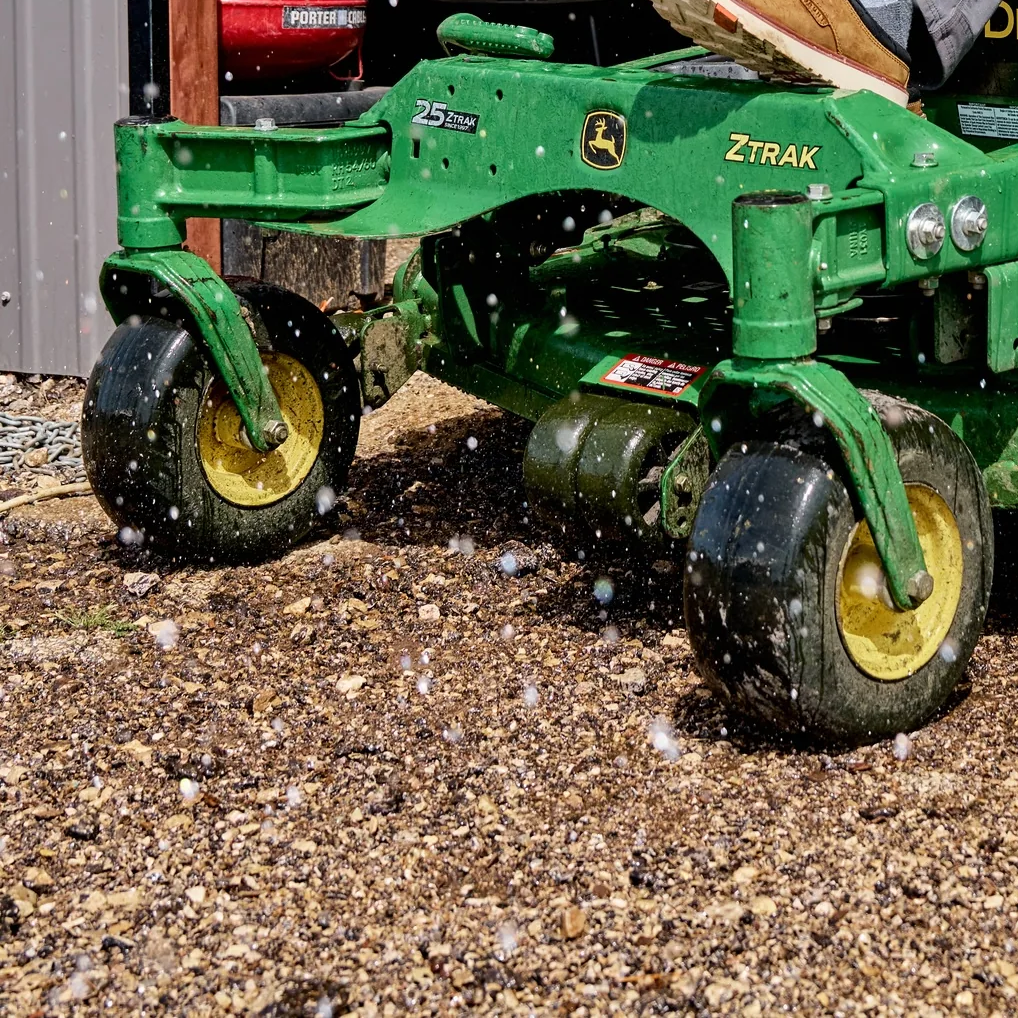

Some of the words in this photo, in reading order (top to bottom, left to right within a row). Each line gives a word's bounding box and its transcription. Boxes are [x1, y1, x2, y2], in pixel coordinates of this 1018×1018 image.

[290, 10, 336, 24] PORTER
[411, 99, 447, 126] 25
[445, 112, 477, 126] ZTRAK
[724, 133, 822, 170] ZTRAK
[640, 356, 664, 366] DANGER
[676, 363, 701, 373] PELIGRO
